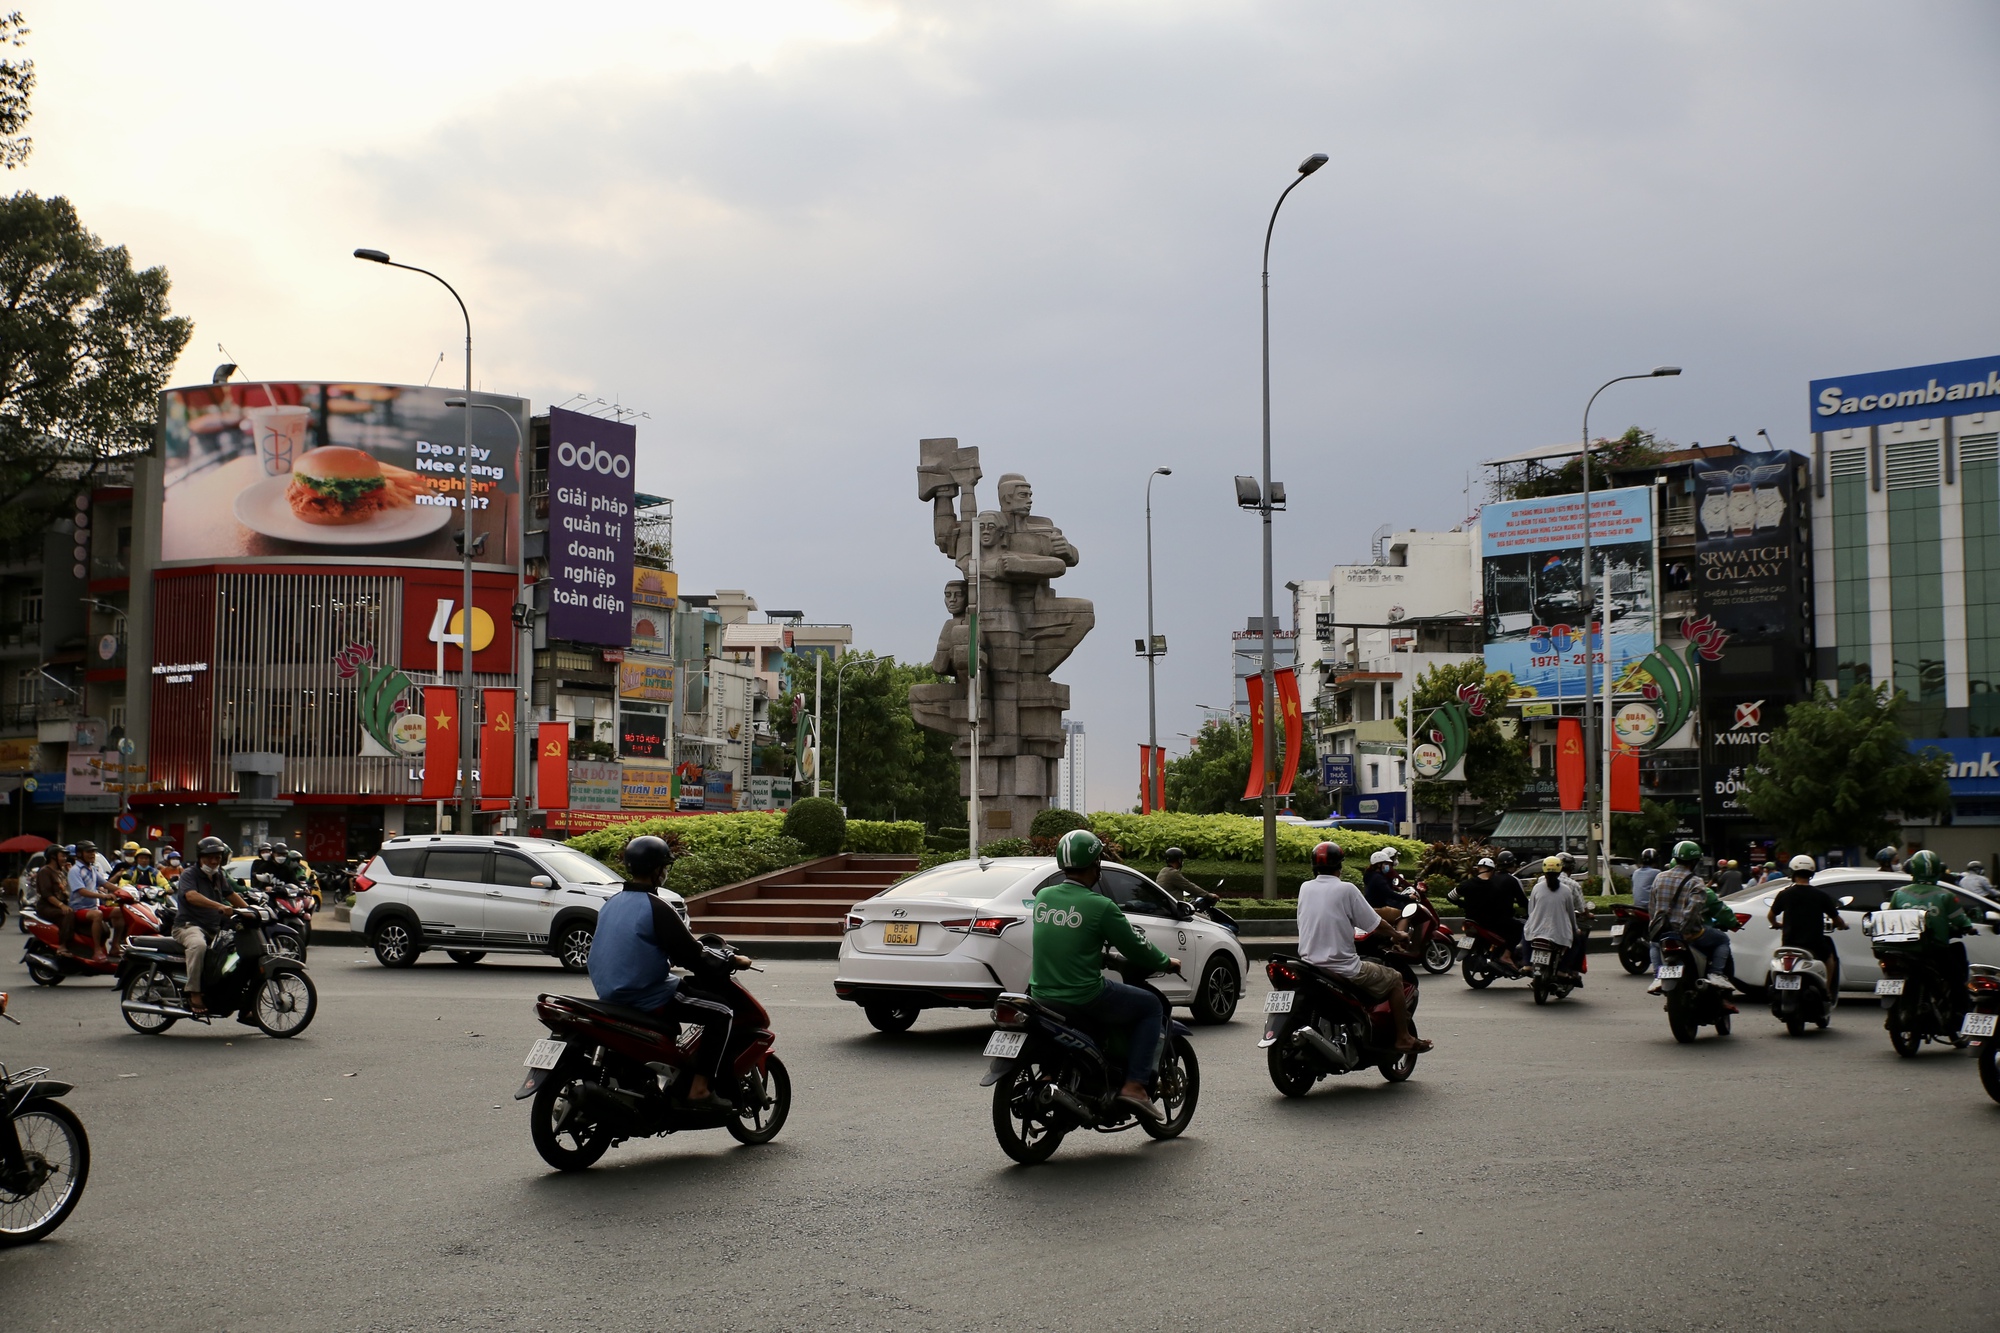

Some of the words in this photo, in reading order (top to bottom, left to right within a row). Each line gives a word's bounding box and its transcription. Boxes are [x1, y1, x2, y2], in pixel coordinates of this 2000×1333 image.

[1816, 371, 2000, 416] Sacombank
[416, 440, 454, 458] Dạo
[458, 444, 490, 461] này
[416, 458, 456, 472] Mee
[558, 440, 630, 478] odoo
[415, 493, 458, 507] món
[557, 487, 587, 507] Giải
[591, 495, 628, 517] pháp
[563, 514, 600, 534] quản
[605, 521, 621, 542] trị
[568, 540, 614, 562] doanh
[1700, 546, 1790, 568] SRWATCH
[564, 566, 616, 588] nghiệp
[1706, 562, 1782, 581] GALAXY
[554, 587, 588, 607] toàn
[592, 594, 624, 614] diện
[1732, 595, 1778, 605] COLLECTION
[1530, 656, 1559, 667] 1975
[645, 668, 673, 679] EPOXY
[645, 678, 672, 688] INTER
[1626, 713, 1646, 722] QUẬN
[404, 722, 422, 732] QUẬN
[1715, 732, 1774, 745] XWATC
[572, 763, 588, 780] ẦM
[607, 770, 618, 780] T2
[753, 788, 768, 796] KHÁM
[1035, 902, 1083, 929] Grab
[894, 924, 909, 933] 83E
[887, 934, 913, 944] 005.41
[1270, 993, 1290, 1002] 59-N1
[1264, 1002, 1290, 1012] 788.35
[1969, 1016, 1992, 1025] 59-F2
[530, 1054, 554, 1067] 6074
